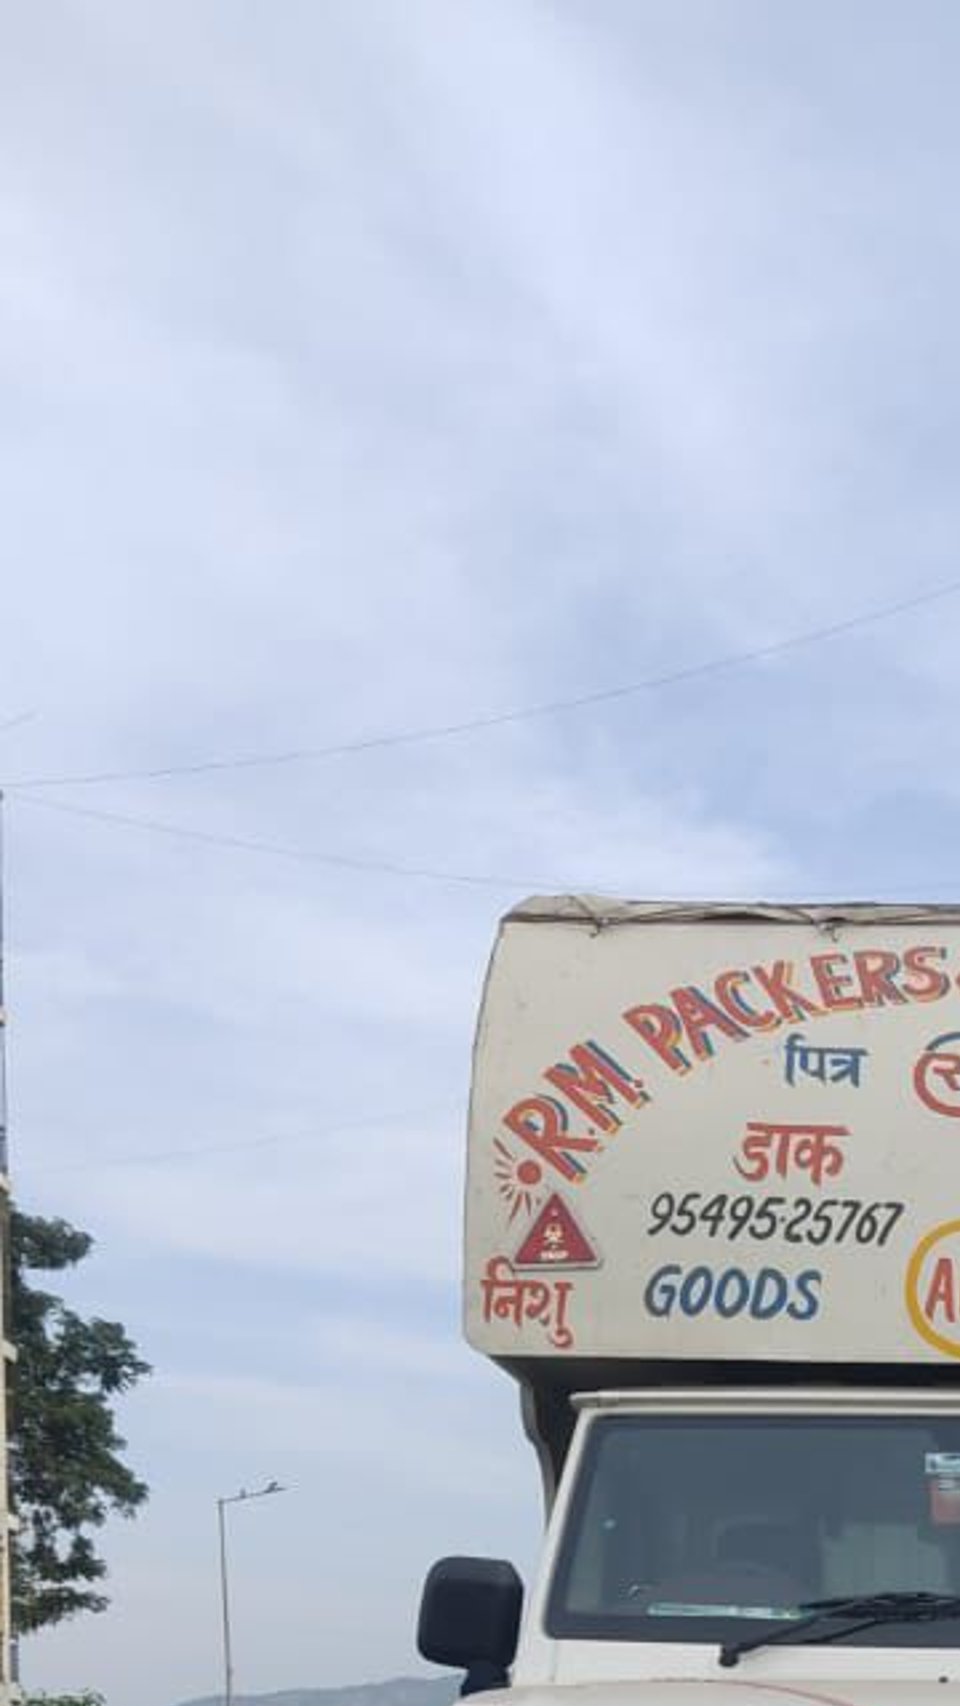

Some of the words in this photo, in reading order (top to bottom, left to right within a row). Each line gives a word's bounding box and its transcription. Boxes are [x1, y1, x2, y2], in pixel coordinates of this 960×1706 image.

[623, 945, 951, 1076] PACKERS
[784, 1033, 870, 1089] पित्र
[732, 1122, 854, 1187] डाक
[480, 1255, 574, 1349] निशु
[644, 1263, 822, 1321] GOODS
